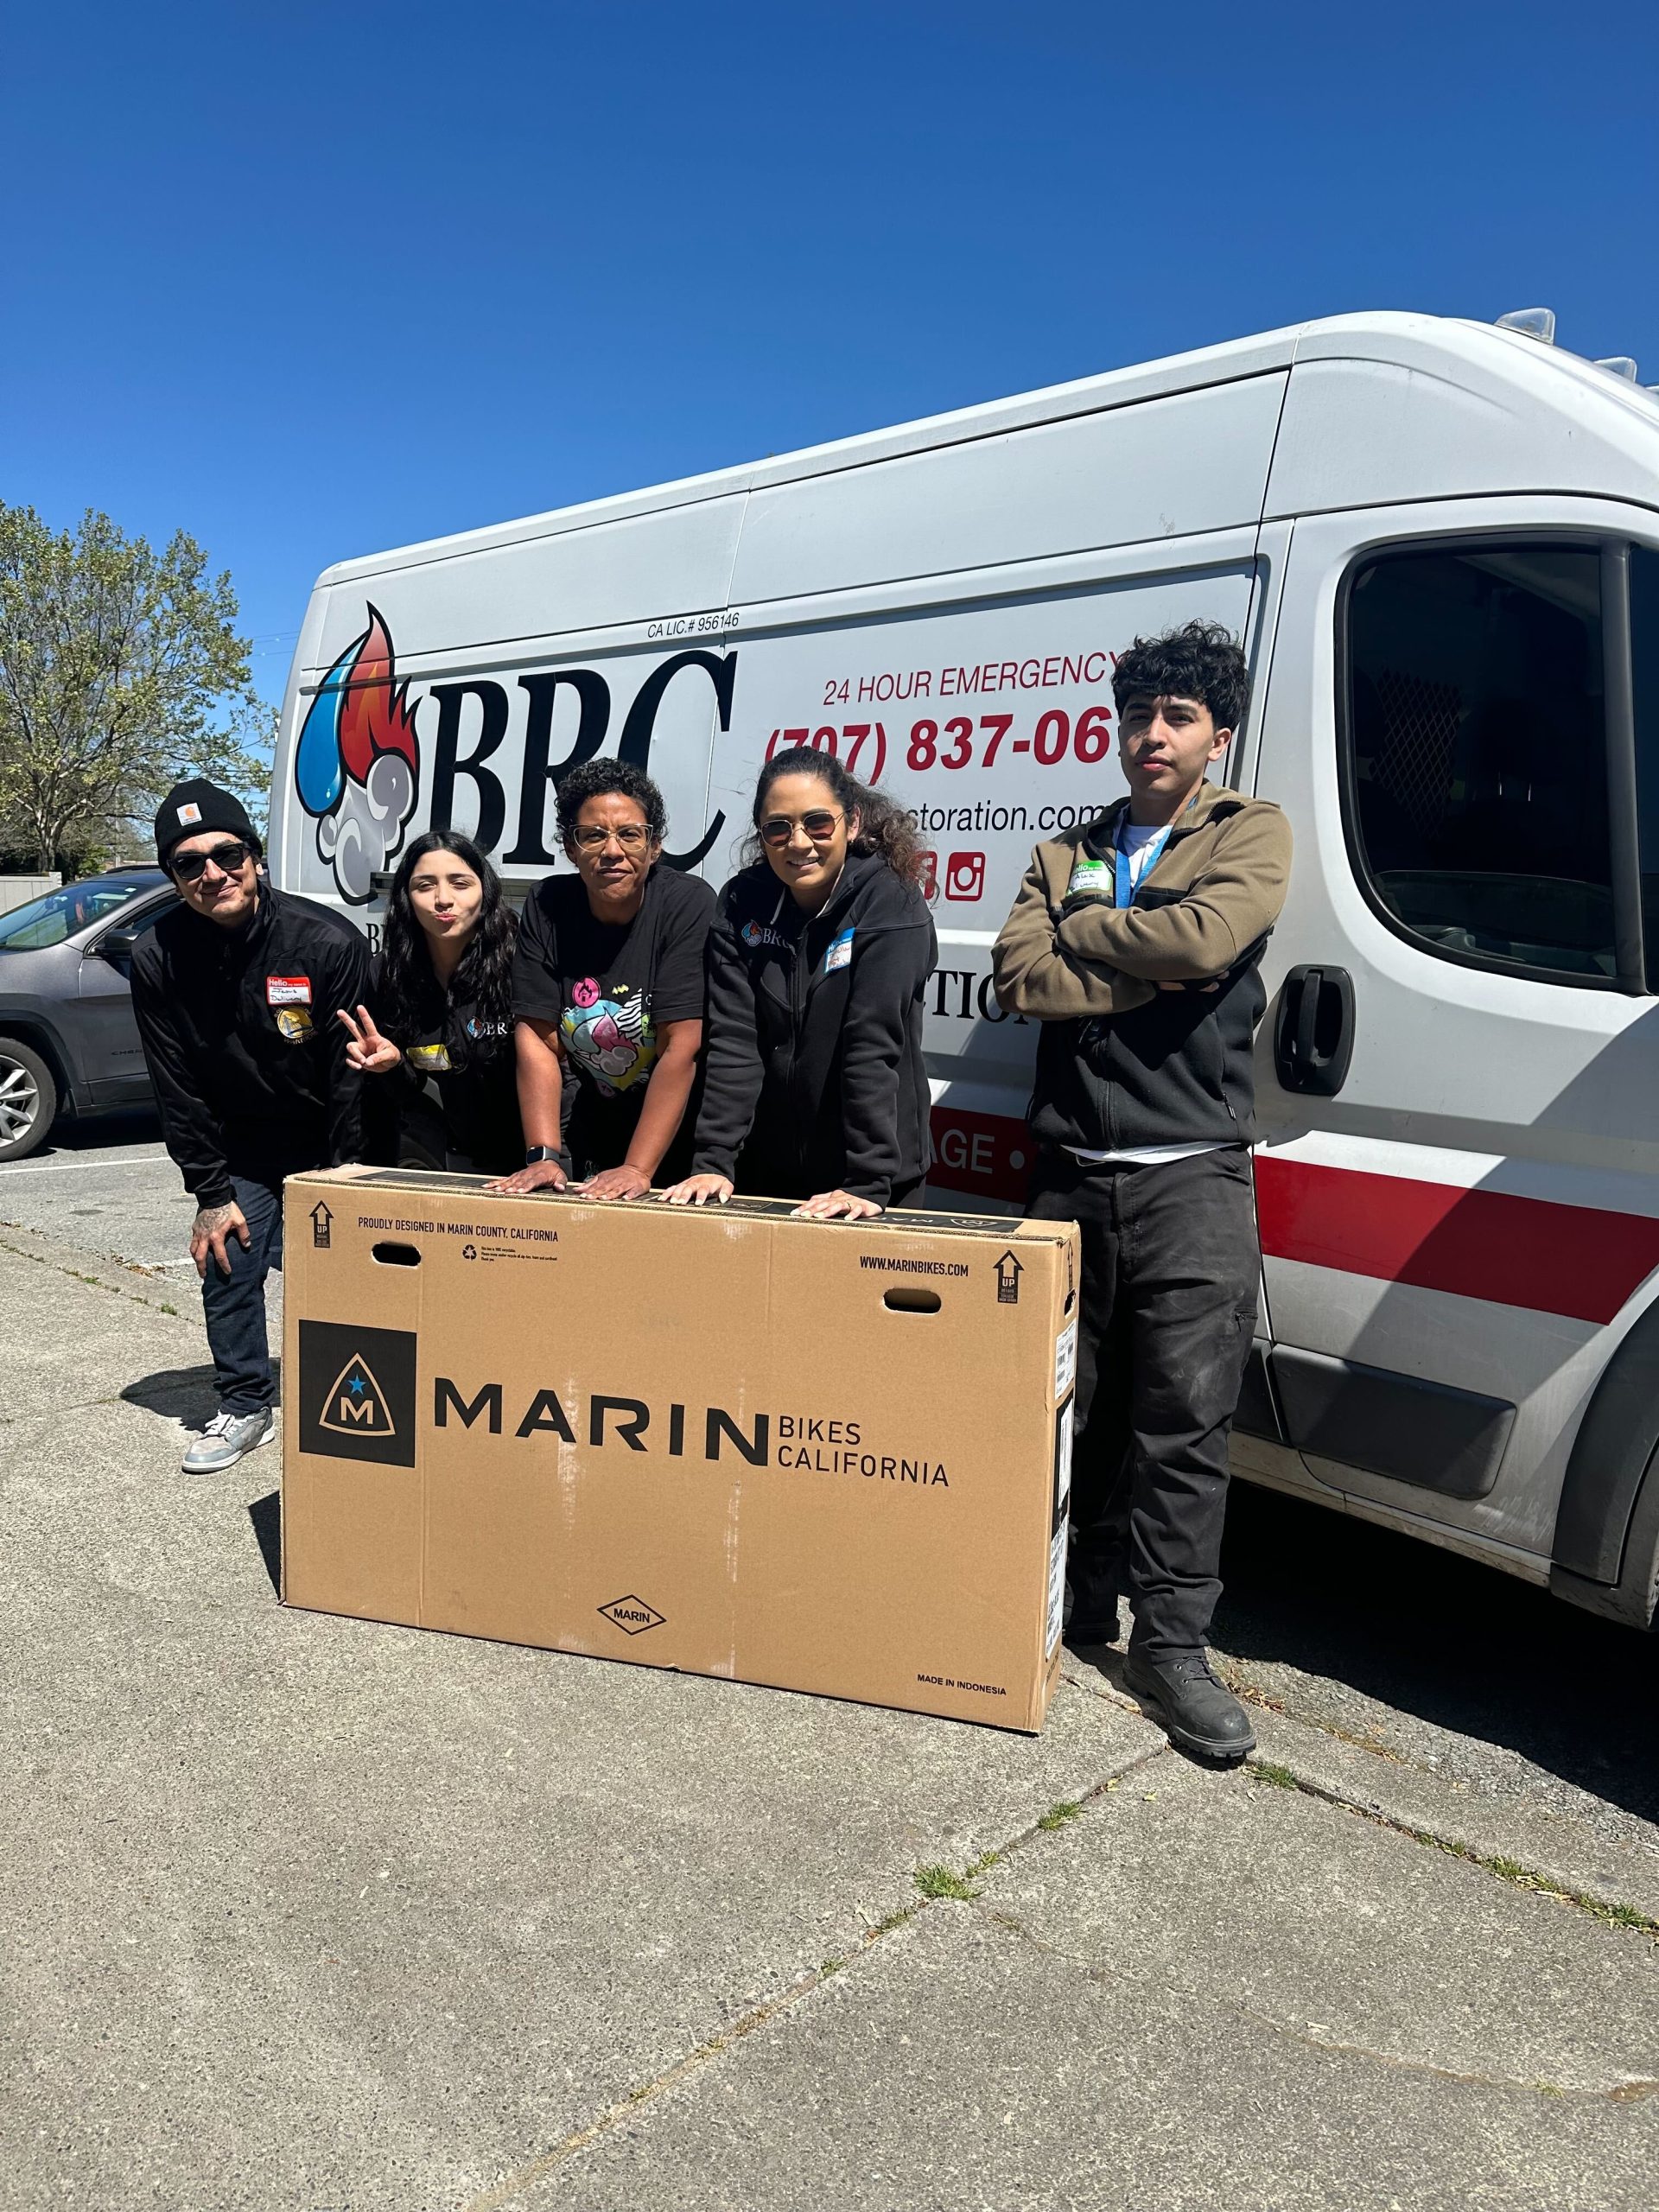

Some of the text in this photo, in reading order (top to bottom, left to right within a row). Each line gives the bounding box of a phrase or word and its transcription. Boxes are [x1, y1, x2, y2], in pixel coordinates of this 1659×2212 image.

[647, 623, 664, 638] CA
[697, 612, 740, 632] 956146
[823, 678, 850, 706] 24
[857, 670, 932, 702] HOUR
[429, 650, 739, 872] BRC
[269, 978, 288, 987] Hello
[316, 1225, 327, 1234] UP
[358, 1217, 393, 1230] PROUDLY
[395, 1219, 435, 1233] DESIGNED
[436, 1222, 445, 1233] IN
[447, 1223, 474, 1236] MARIN
[511, 1228, 558, 1242] CALIFORNIA
[860, 1255, 969, 1278] WWW.MARINBIKES.COM
[1001, 1278, 1015, 1287] UP
[340, 1396, 374, 1425] M
[435, 1377, 769, 1466] MARIN
[779, 1415, 861, 1446] BIKES
[778, 1445, 950, 1488] CALIFORNIA
[613, 1607, 651, 1624] MARIN
[917, 1673, 1007, 1696] MADE IN INDONESIA
